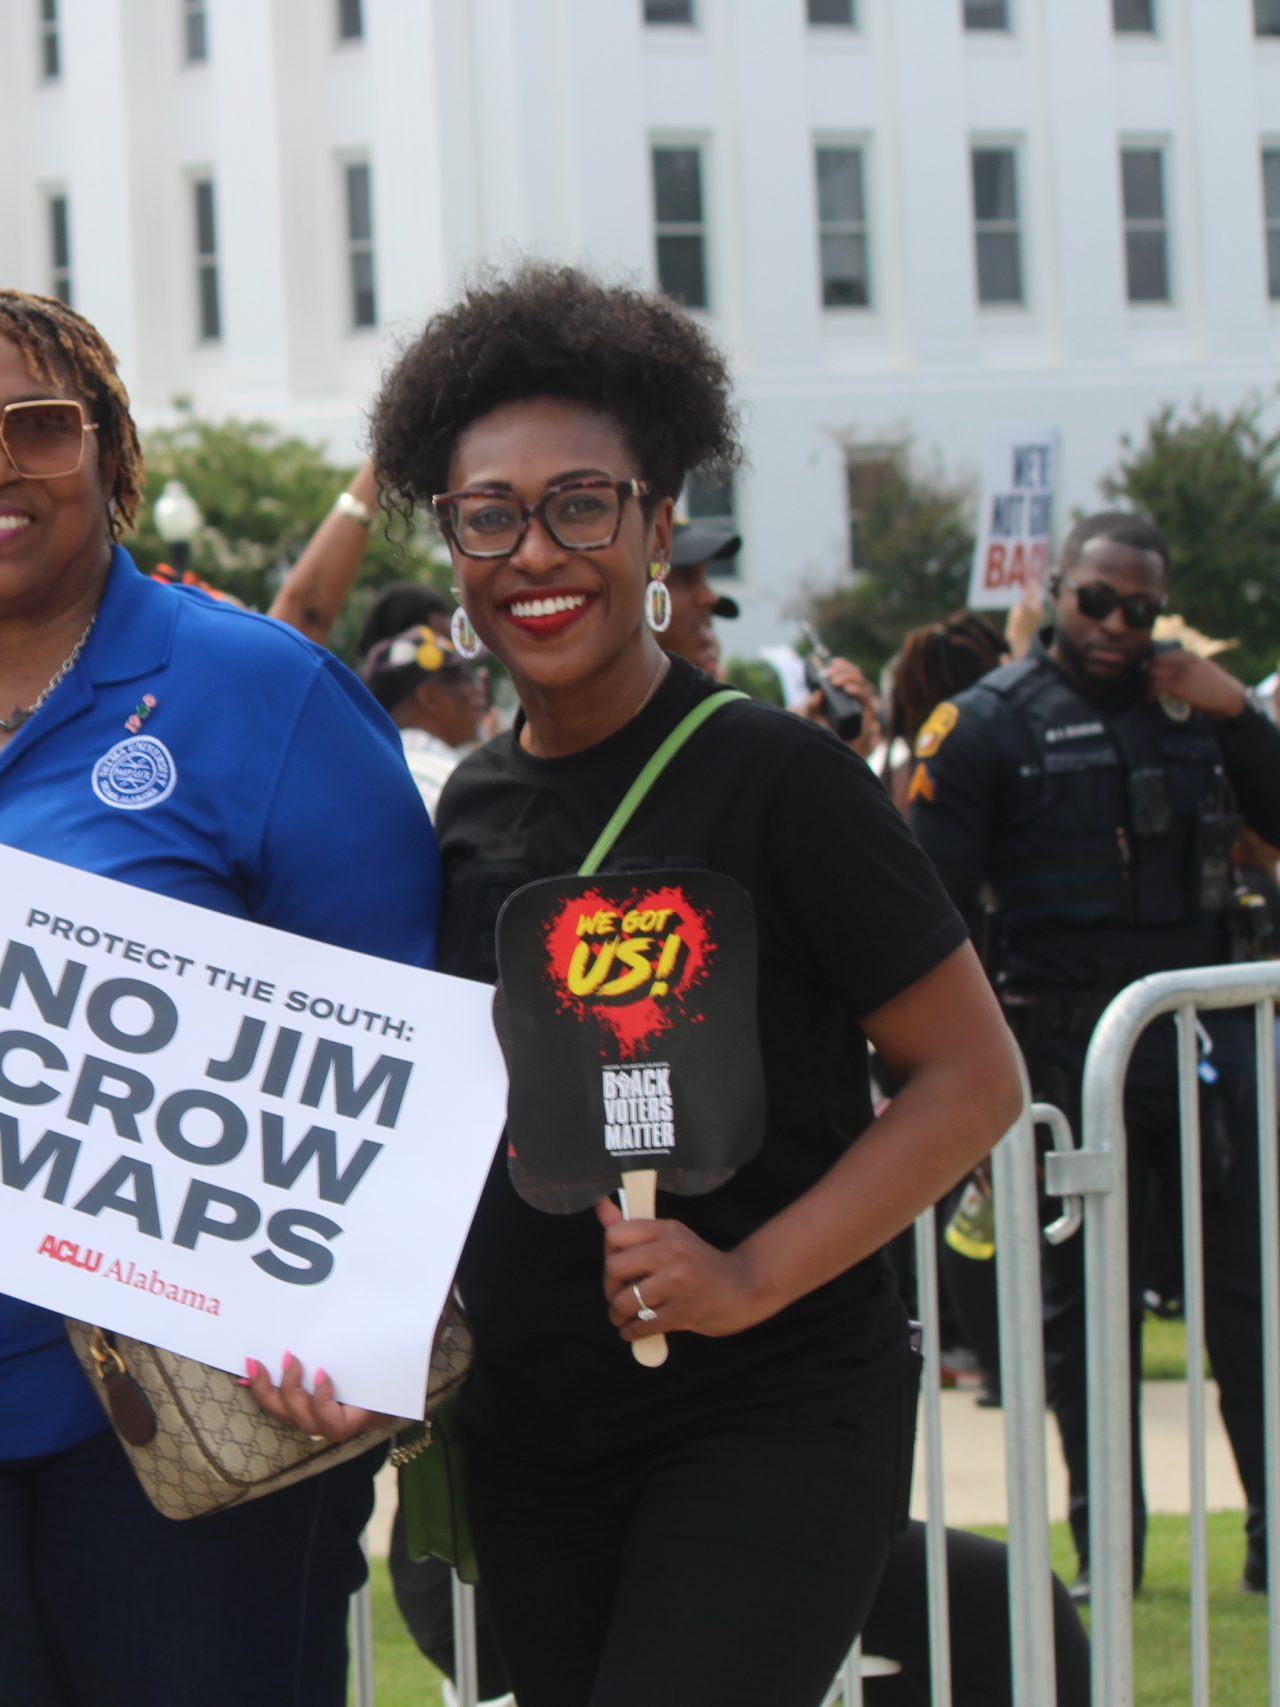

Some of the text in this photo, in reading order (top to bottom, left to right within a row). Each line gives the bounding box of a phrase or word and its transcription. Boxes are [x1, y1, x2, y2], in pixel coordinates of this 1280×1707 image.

[576, 908, 673, 936] WE GOT
[26, 908, 416, 1042] PROTECT THE SOUTH:
[567, 933, 681, 998] US!
[205, 1015, 415, 1130] JIM
[603, 1096, 674, 1125] VOTERS
[604, 1122, 675, 1150] MATTER
[37, 1234, 221, 1317] ACLU Alabama
